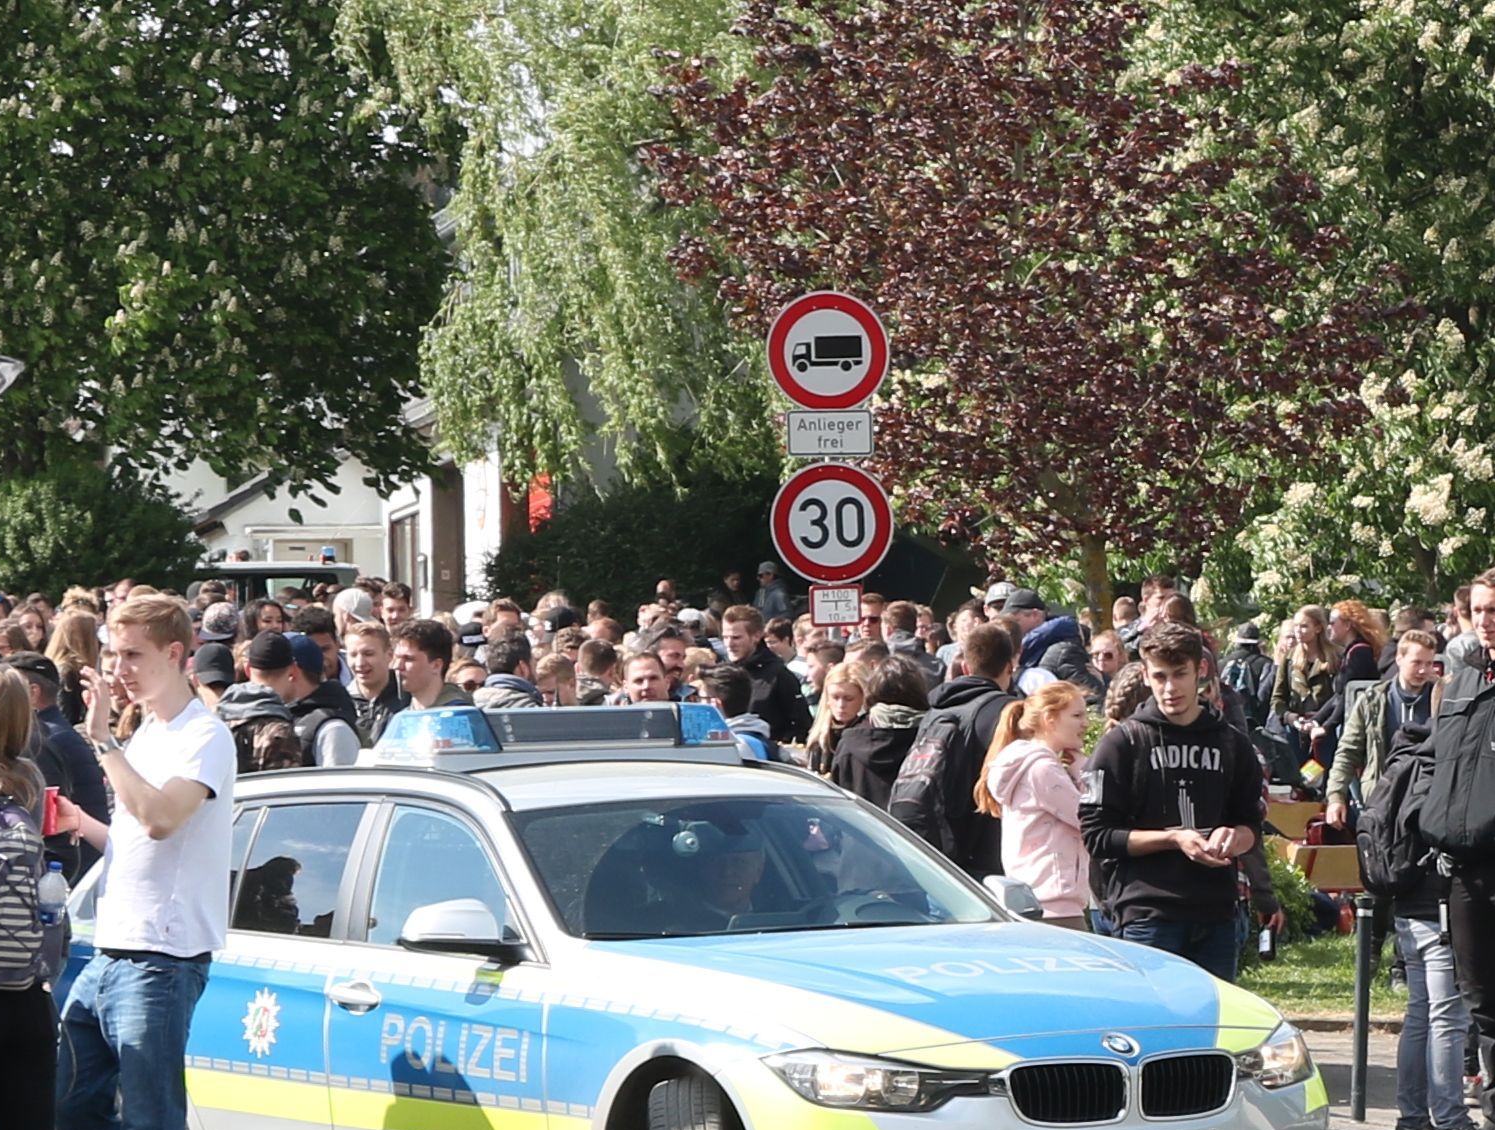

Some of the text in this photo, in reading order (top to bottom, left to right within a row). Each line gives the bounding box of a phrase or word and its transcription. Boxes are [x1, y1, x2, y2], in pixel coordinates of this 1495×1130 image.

[797, 418, 862, 434] Anlieger
[817, 435, 843, 448] frei
[799, 497, 865, 549] 30
[885, 956, 1138, 984] POLIZEI
[380, 1012, 530, 1083] POLIZEI
